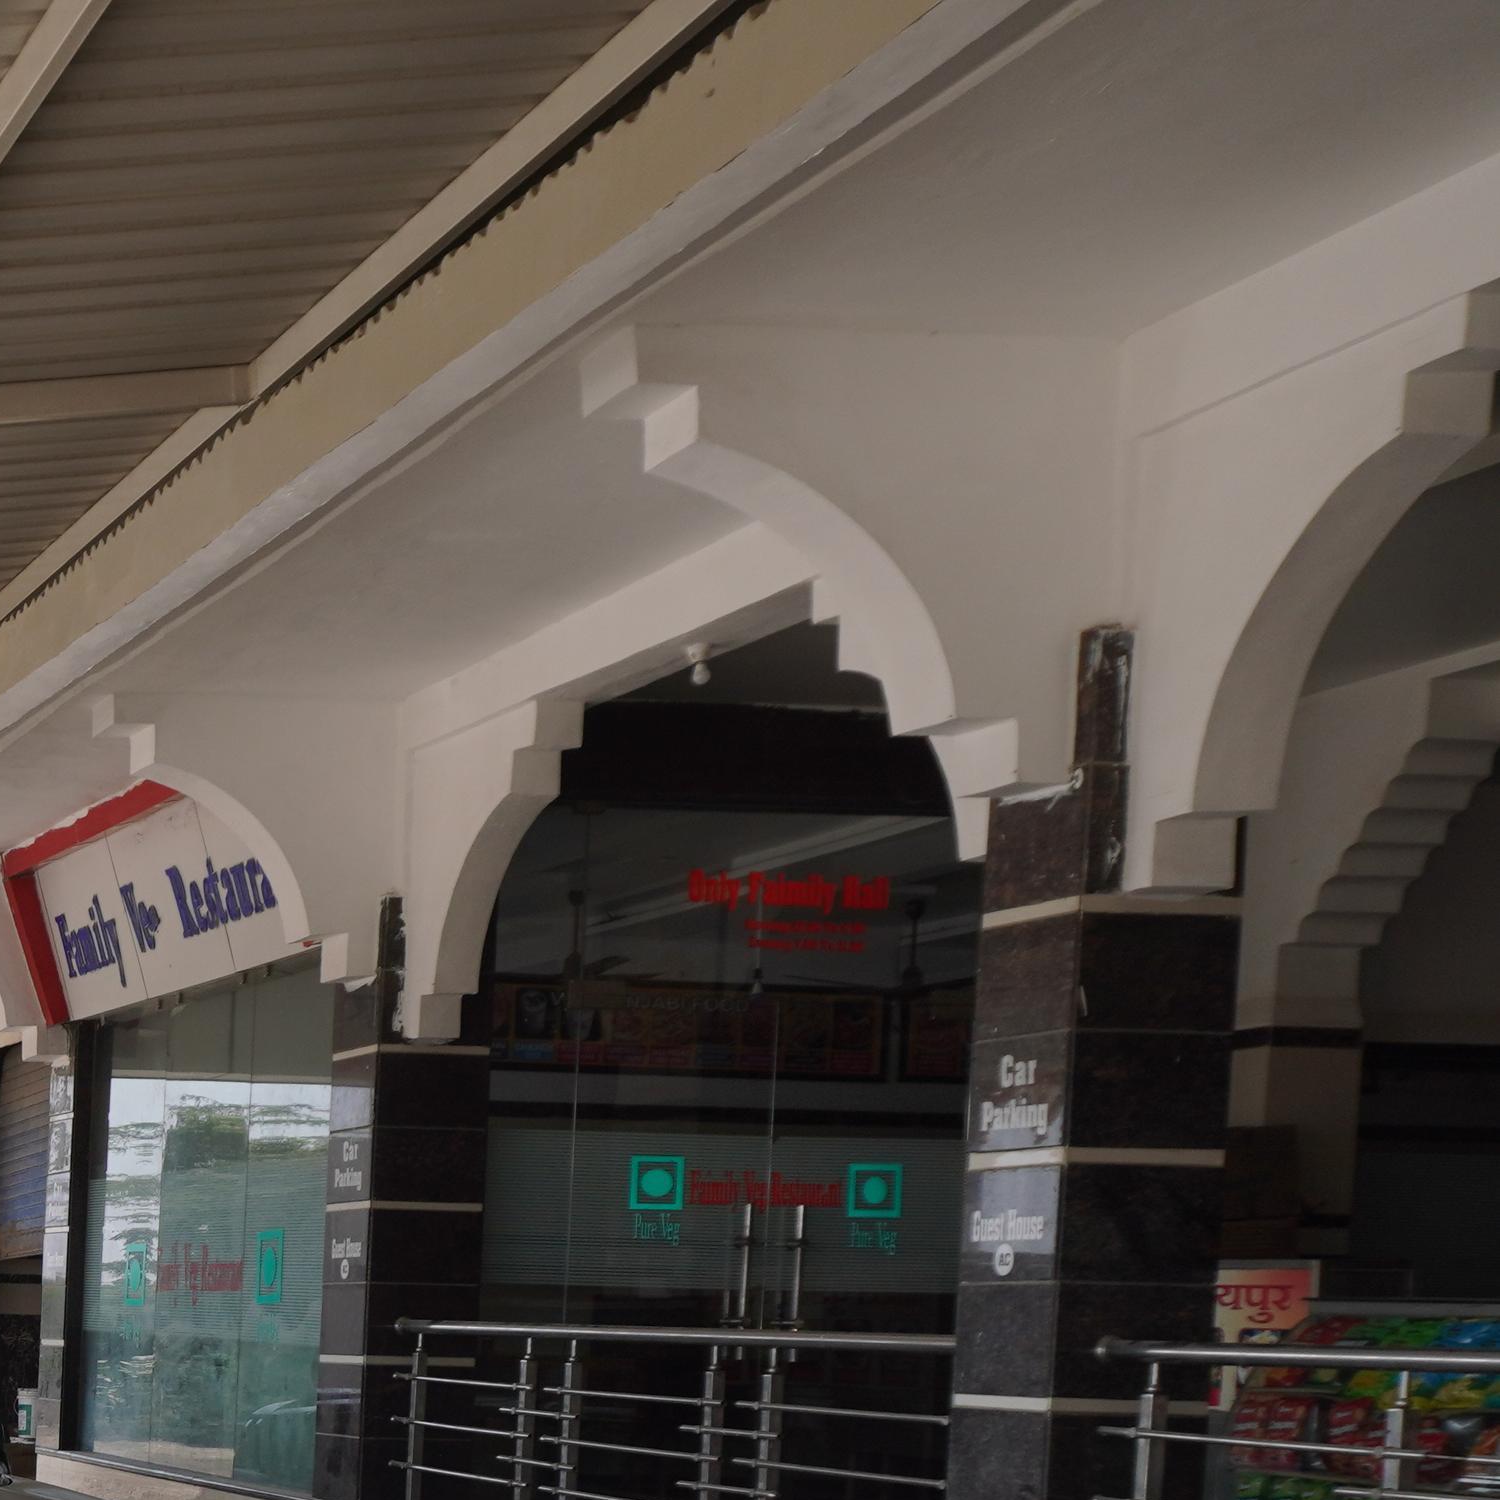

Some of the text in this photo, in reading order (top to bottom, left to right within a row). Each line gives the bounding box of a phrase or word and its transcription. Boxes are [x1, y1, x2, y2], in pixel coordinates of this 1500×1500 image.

[688, 868, 742, 912] Only
[55, 894, 127, 988] Family
[999, 1054, 1038, 1088] Car
[980, 1097, 1049, 1135] Parking
[343, 1140, 358, 1162] Car
[334, 1166, 362, 1191] Parking
[633, 1213, 681, 1246] Pure Veg
[972, 1208, 1044, 1243] Guest House
[331, 1236, 362, 1260] Guest House
